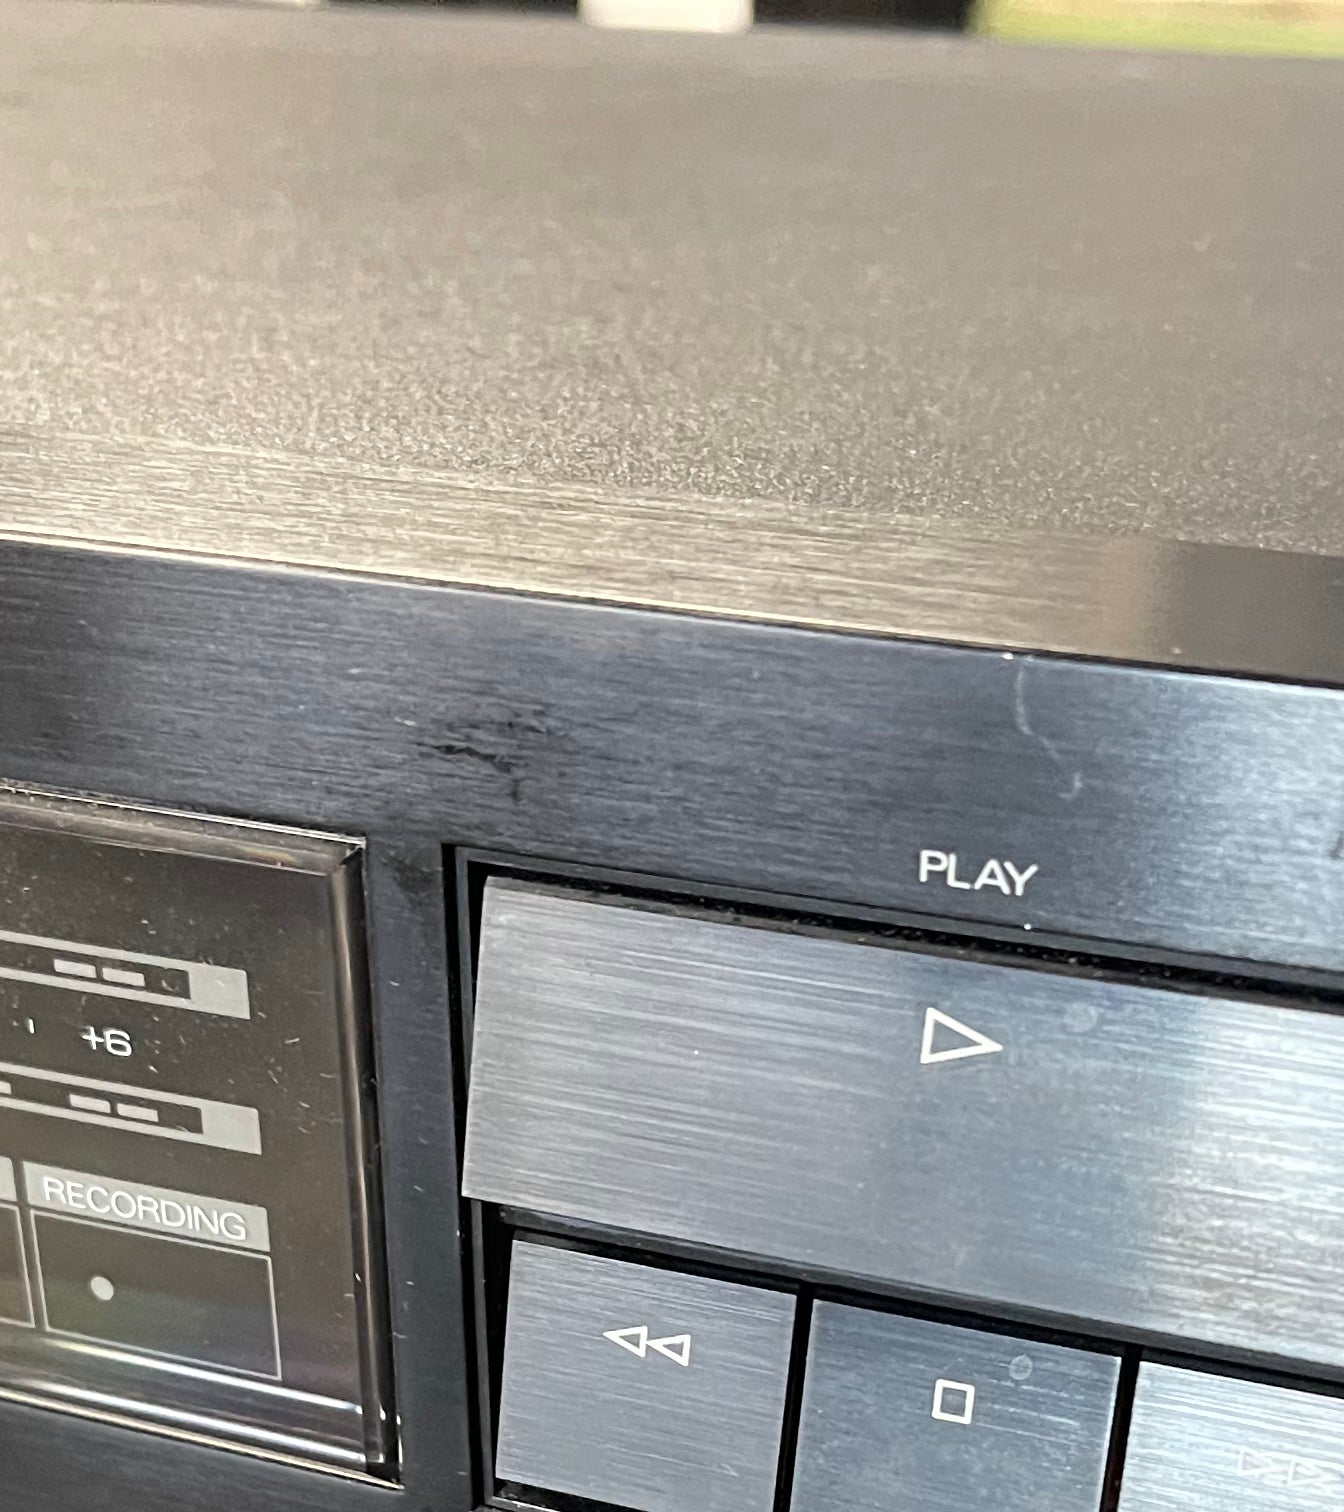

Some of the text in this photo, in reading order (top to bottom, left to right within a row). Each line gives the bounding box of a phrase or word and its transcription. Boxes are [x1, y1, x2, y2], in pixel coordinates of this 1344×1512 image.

[917, 849, 1039, 899] PLAY
[81, 1025, 133, 1058] +6
[42, 1176, 248, 1242] RECORDING
